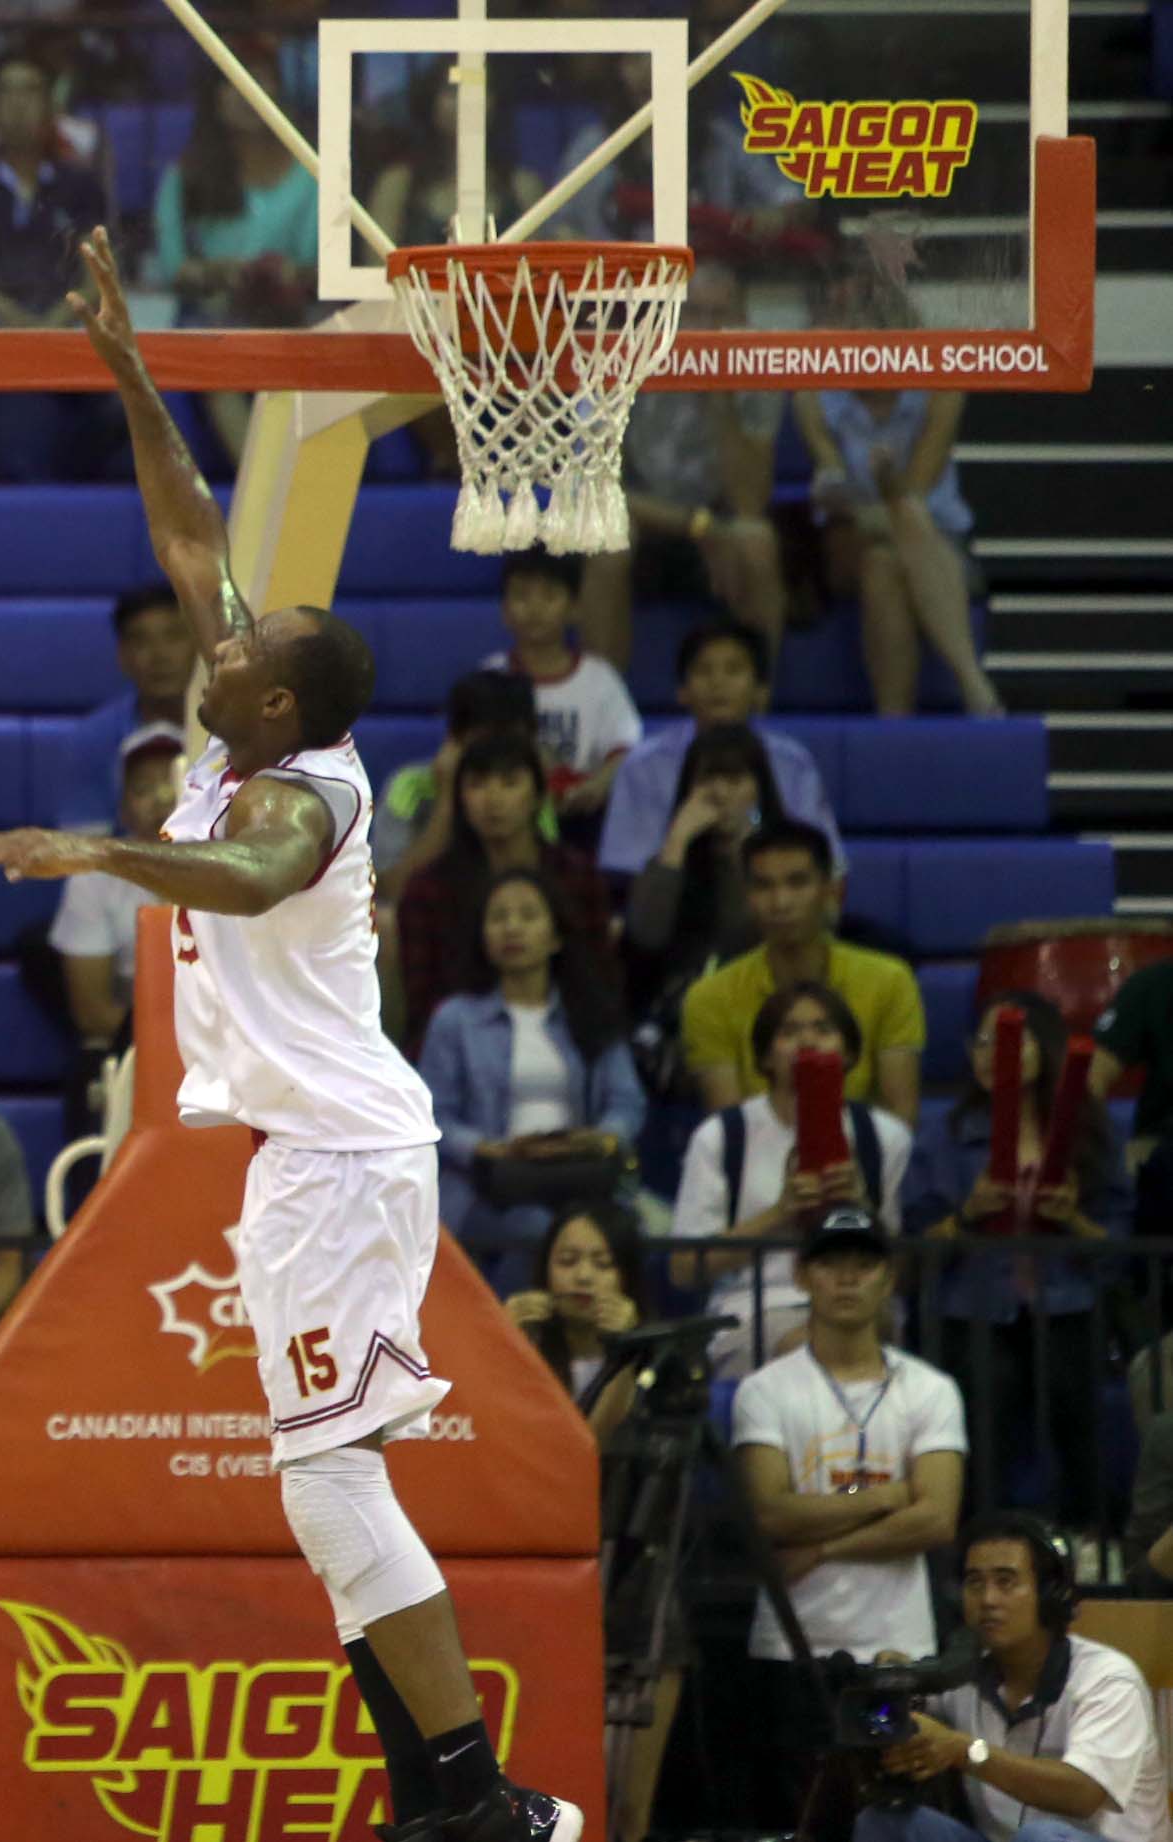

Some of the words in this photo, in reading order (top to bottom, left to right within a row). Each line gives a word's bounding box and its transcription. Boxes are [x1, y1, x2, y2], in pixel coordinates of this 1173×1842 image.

[746, 104, 977, 151] SAIGON
[807, 150, 968, 196] HEAT
[726, 345, 933, 374] INTERNATIONAL
[941, 344, 1048, 373] SCHOOL
[209, 1296, 252, 1326] CI
[287, 1326, 339, 1398] 15
[46, 1413, 181, 1440] CANADIAN
[187, 1413, 272, 1439] INTERN
[429, 1416, 476, 1441] OOL
[170, 1453, 210, 1477] CIS
[162, 1767, 396, 1842] HEA
